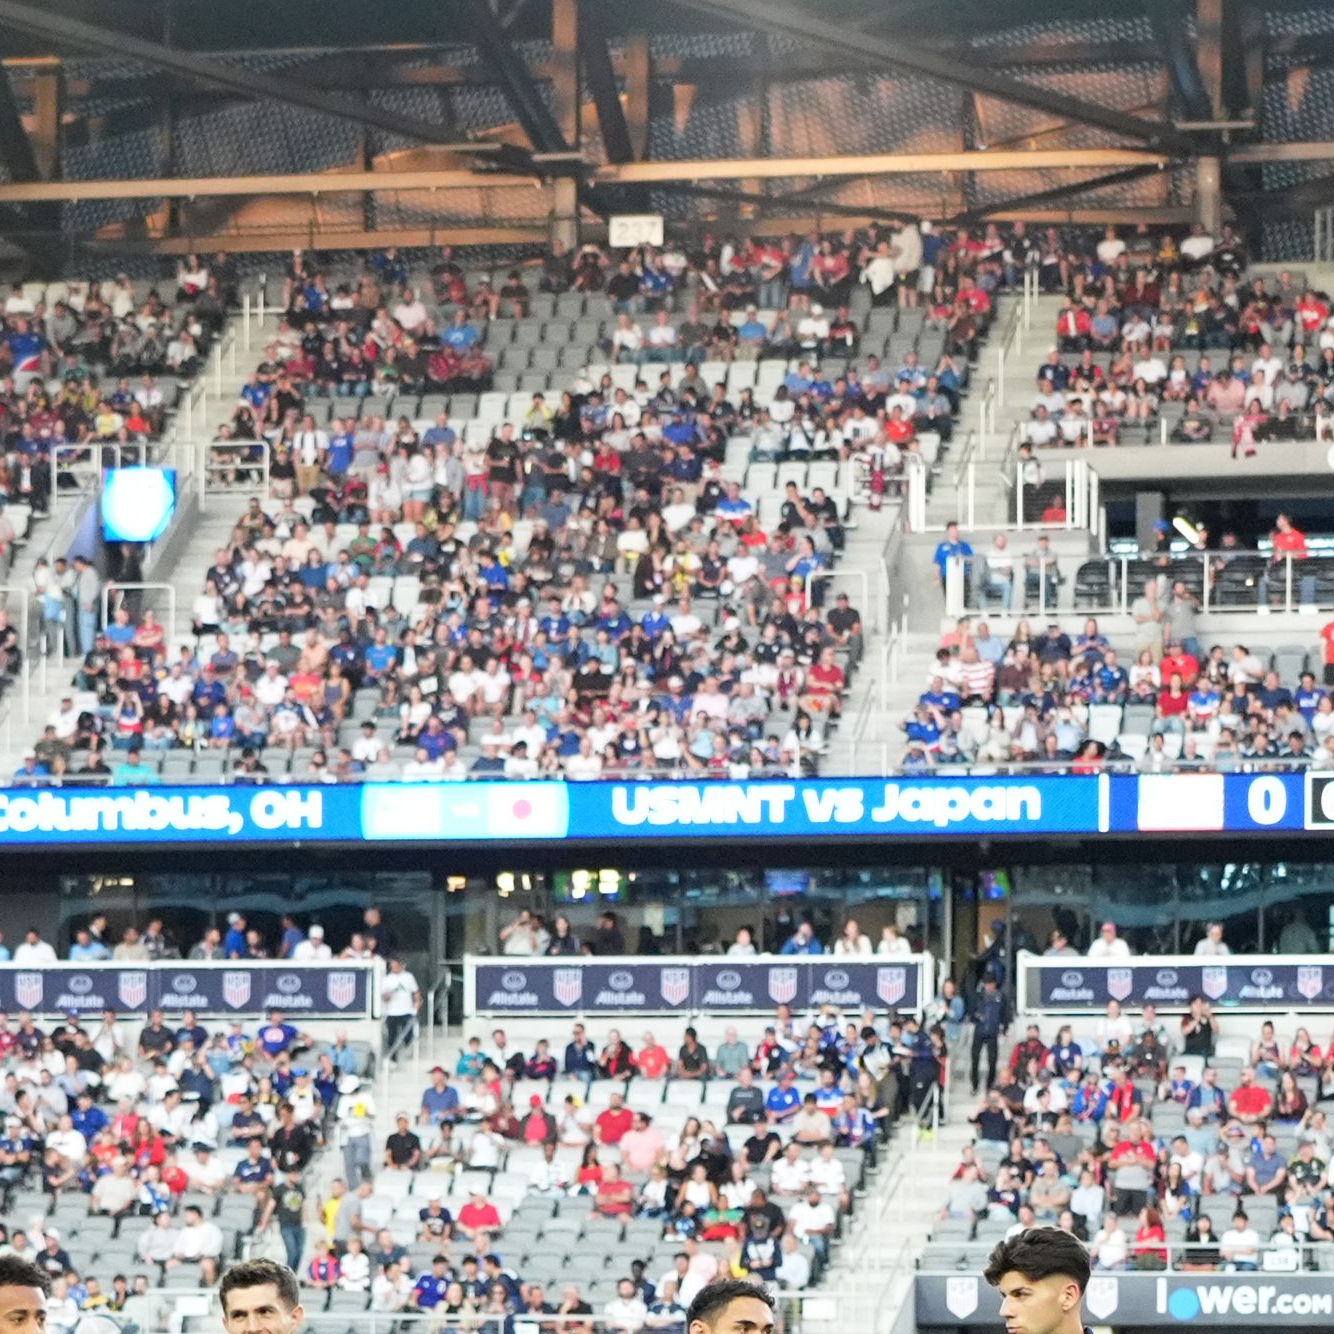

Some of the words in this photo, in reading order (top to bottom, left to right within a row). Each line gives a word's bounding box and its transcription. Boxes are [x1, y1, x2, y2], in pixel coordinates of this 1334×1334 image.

[250, 791, 322, 828] OH
[612, 785, 795, 825] USMNT
[802, 787, 864, 823] vs
[871, 784, 1041, 827] Japan
[1247, 775, 1287, 825] 0
